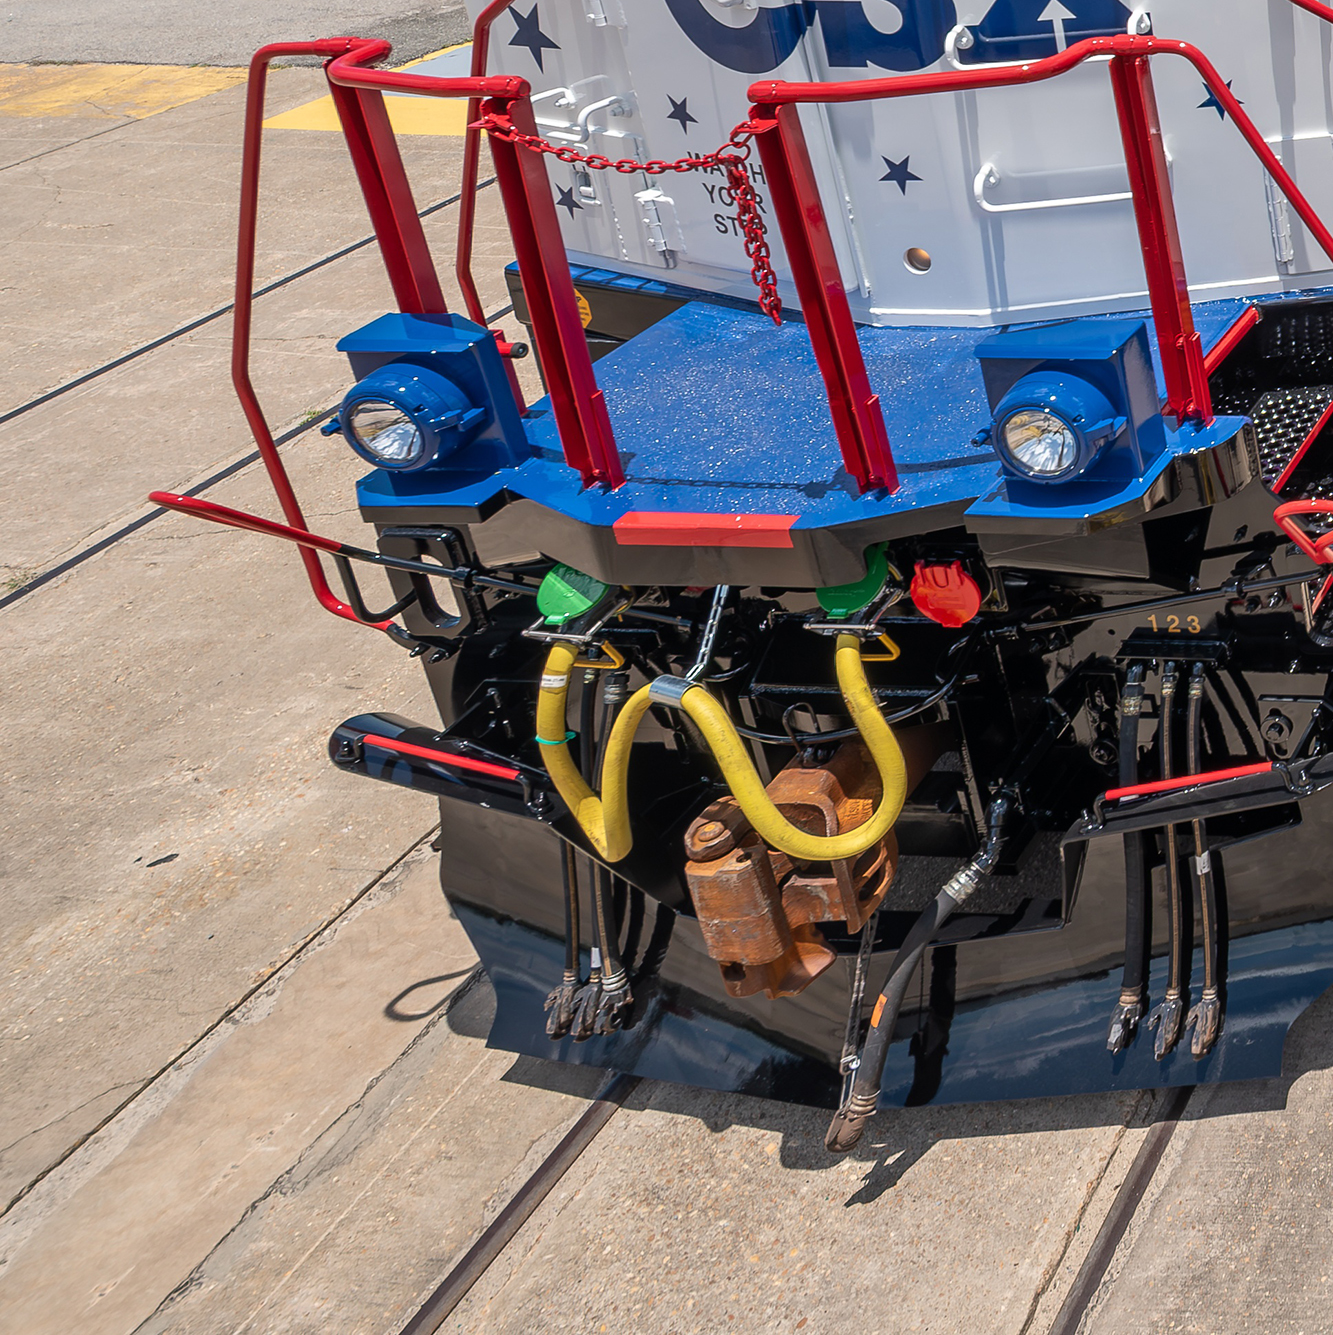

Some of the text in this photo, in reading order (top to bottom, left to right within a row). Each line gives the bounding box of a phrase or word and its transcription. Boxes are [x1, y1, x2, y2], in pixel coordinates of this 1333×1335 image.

[1147, 614, 1201, 633] 1 2 3
